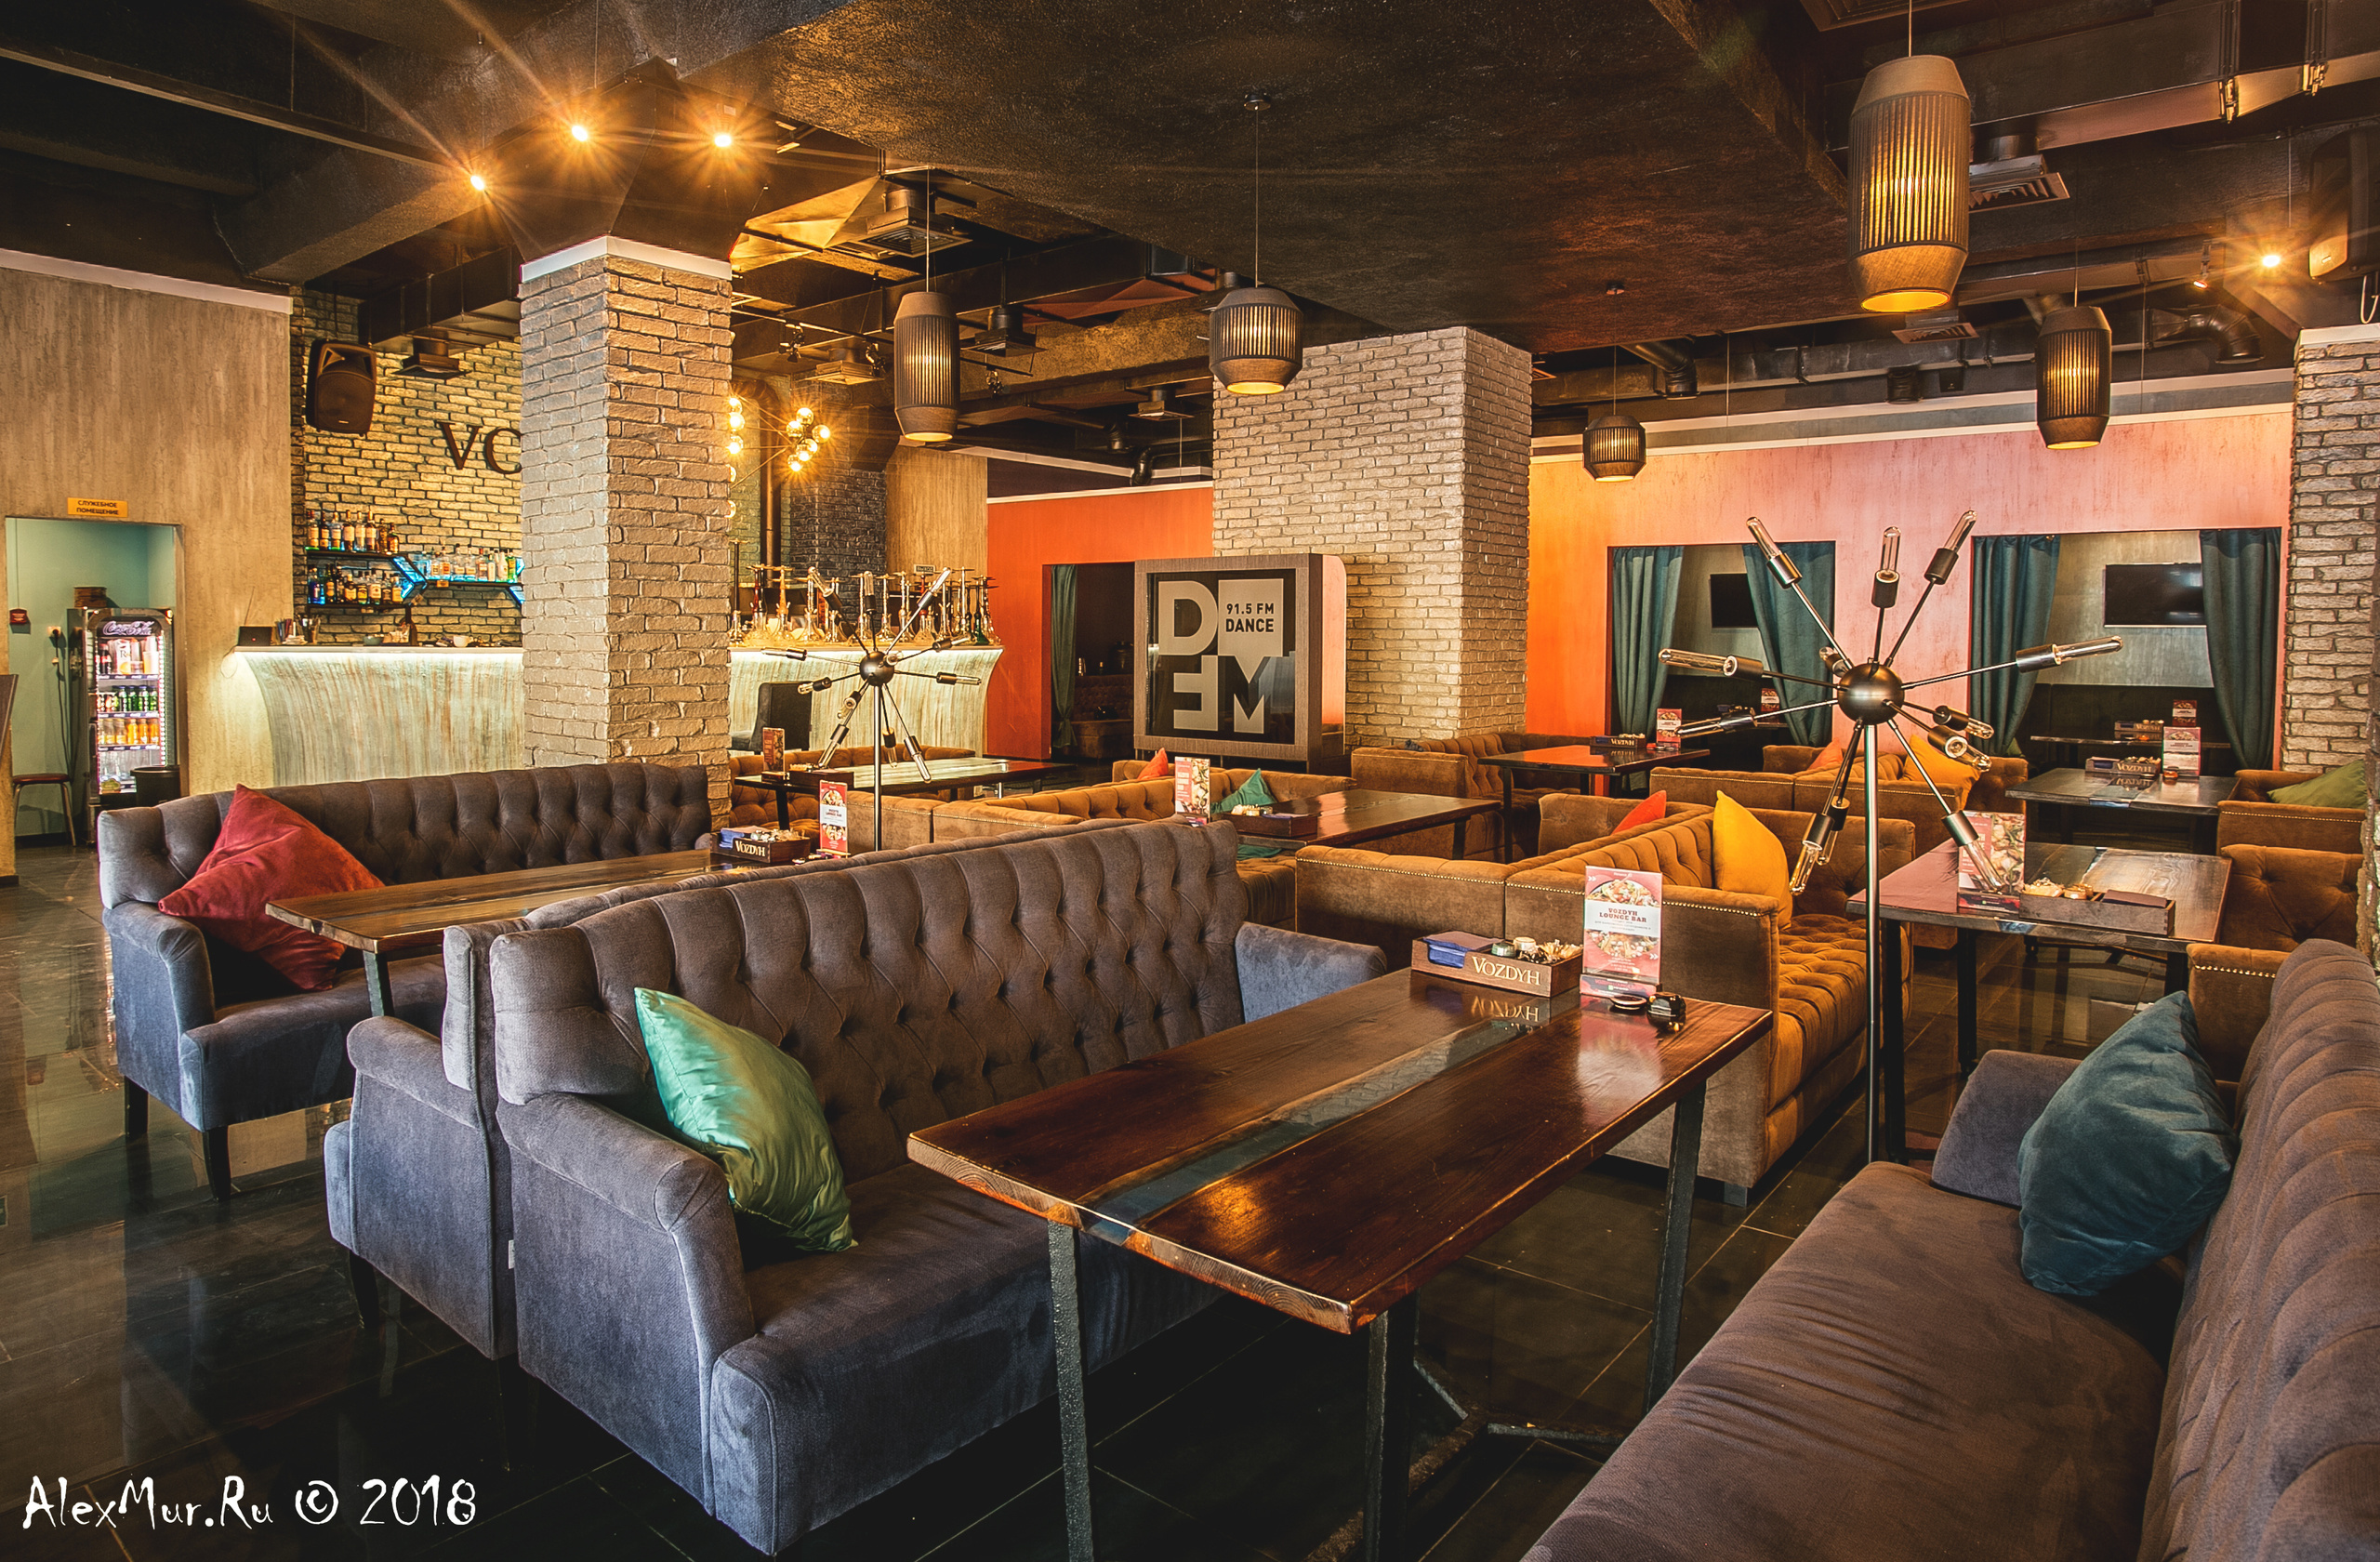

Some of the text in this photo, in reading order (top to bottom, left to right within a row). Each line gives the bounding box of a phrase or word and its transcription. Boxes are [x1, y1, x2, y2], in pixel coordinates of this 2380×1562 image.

[1226, 602, 1275, 615] 91.5 FM
[1225, 618, 1275, 632] DANCE
[734, 840, 766, 857] VOZDYH
[1599, 912, 1630, 920] LOUNGE
[1608, 907, 1638, 917] VOZDYH
[1472, 956, 1540, 986] VOZDYH
